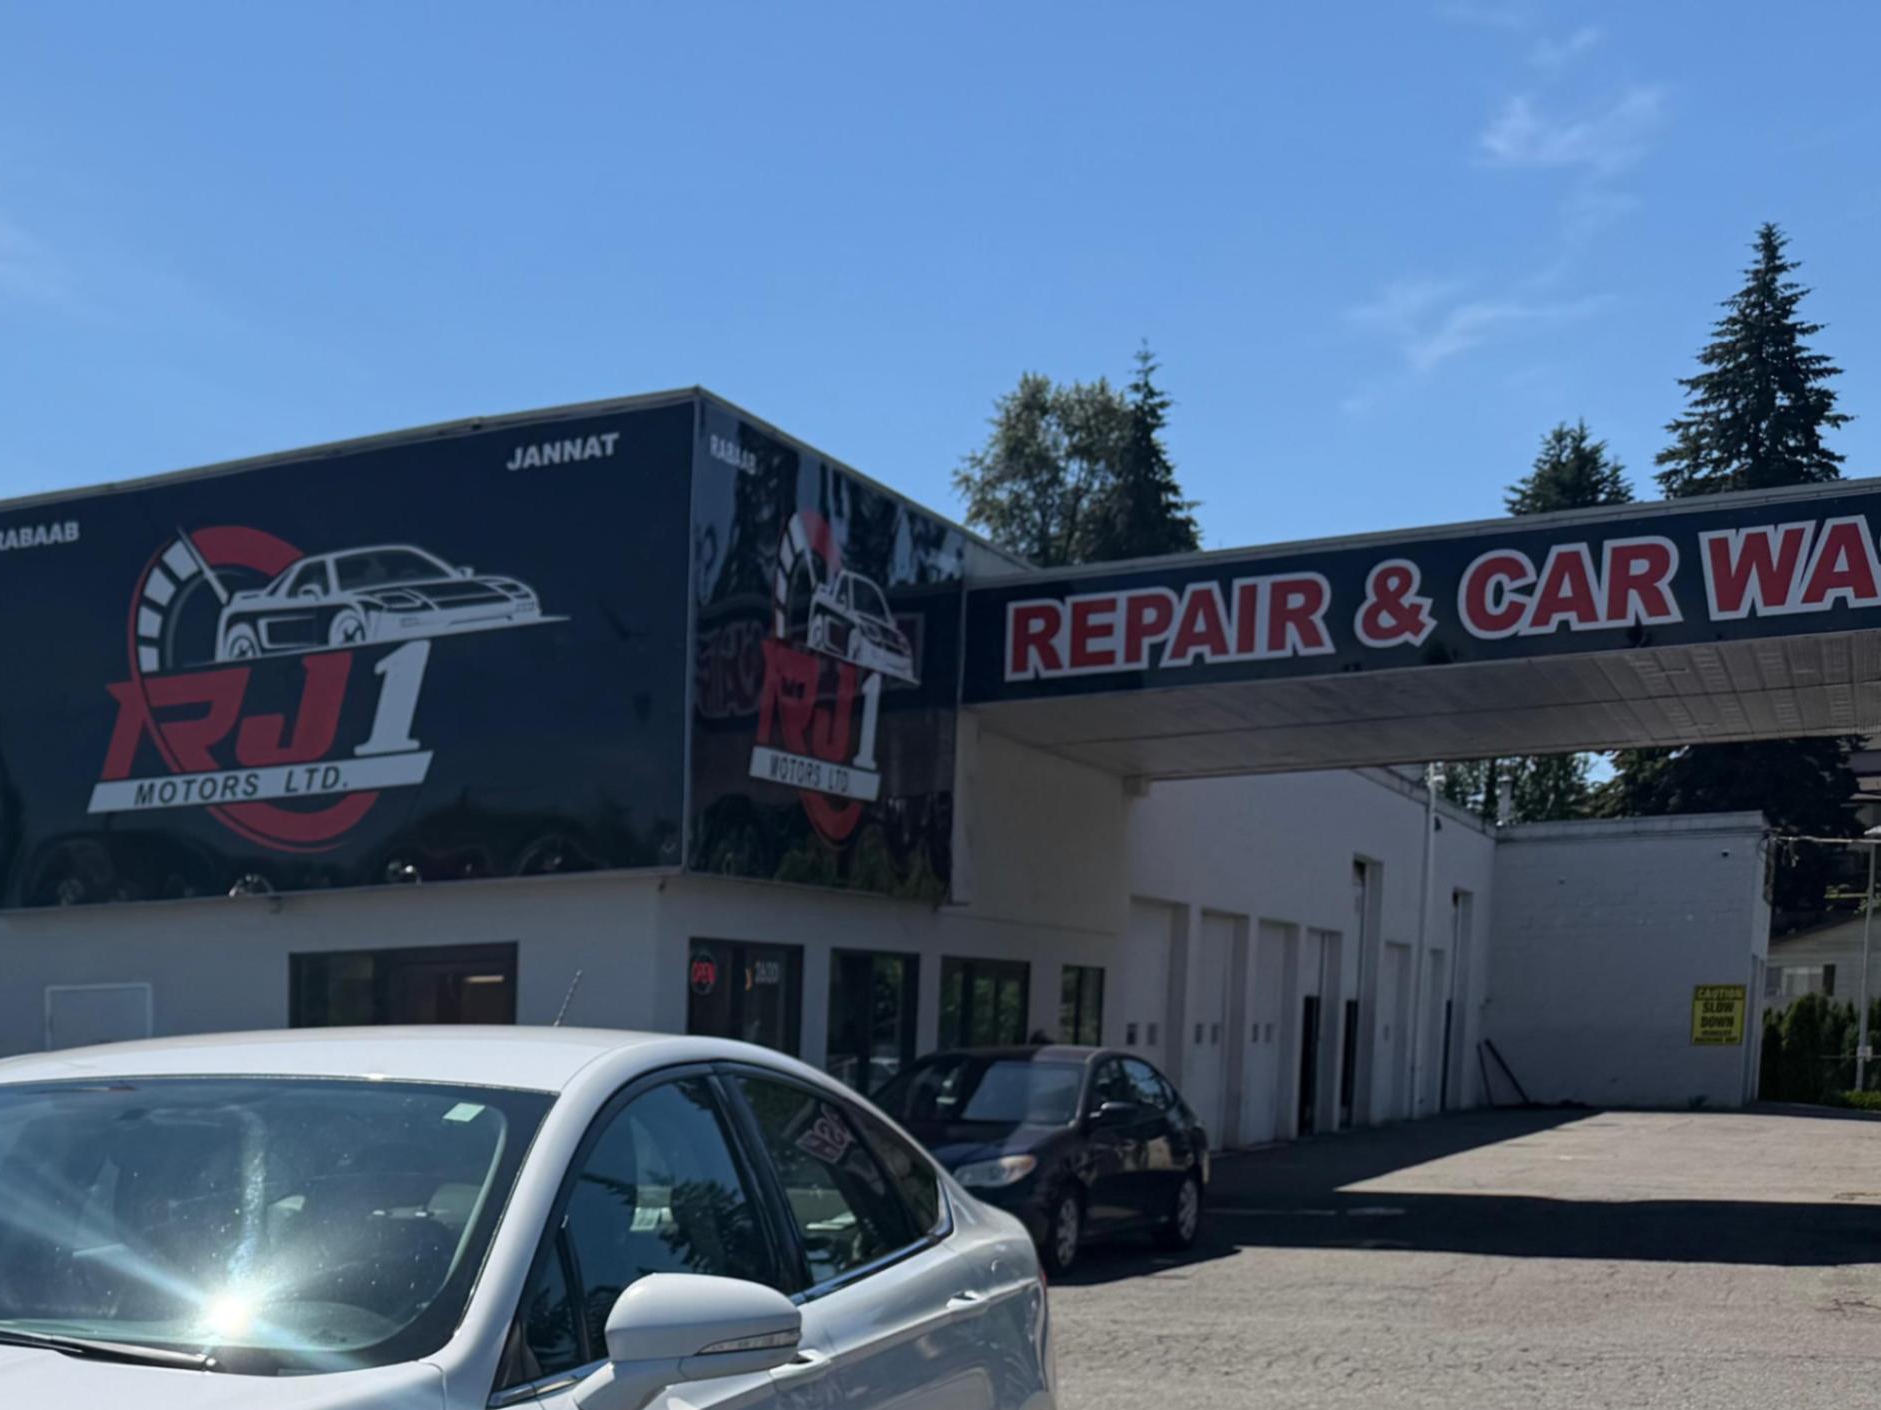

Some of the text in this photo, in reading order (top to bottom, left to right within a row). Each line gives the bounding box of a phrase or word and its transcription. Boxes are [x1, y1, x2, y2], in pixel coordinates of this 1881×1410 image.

[506, 431, 620, 471] JANNAT
[1004, 514, 1881, 682] REPAIR & CAR WA
[101, 639, 432, 780] RJ1
[757, 639, 881, 770] RJ1
[134, 766, 349, 806] MOTORS LTD.
[769, 754, 821, 787] MOTORS
[1700, 1015, 1735, 1028] DOWN
[1702, 1001, 1735, 1013] SLOW
